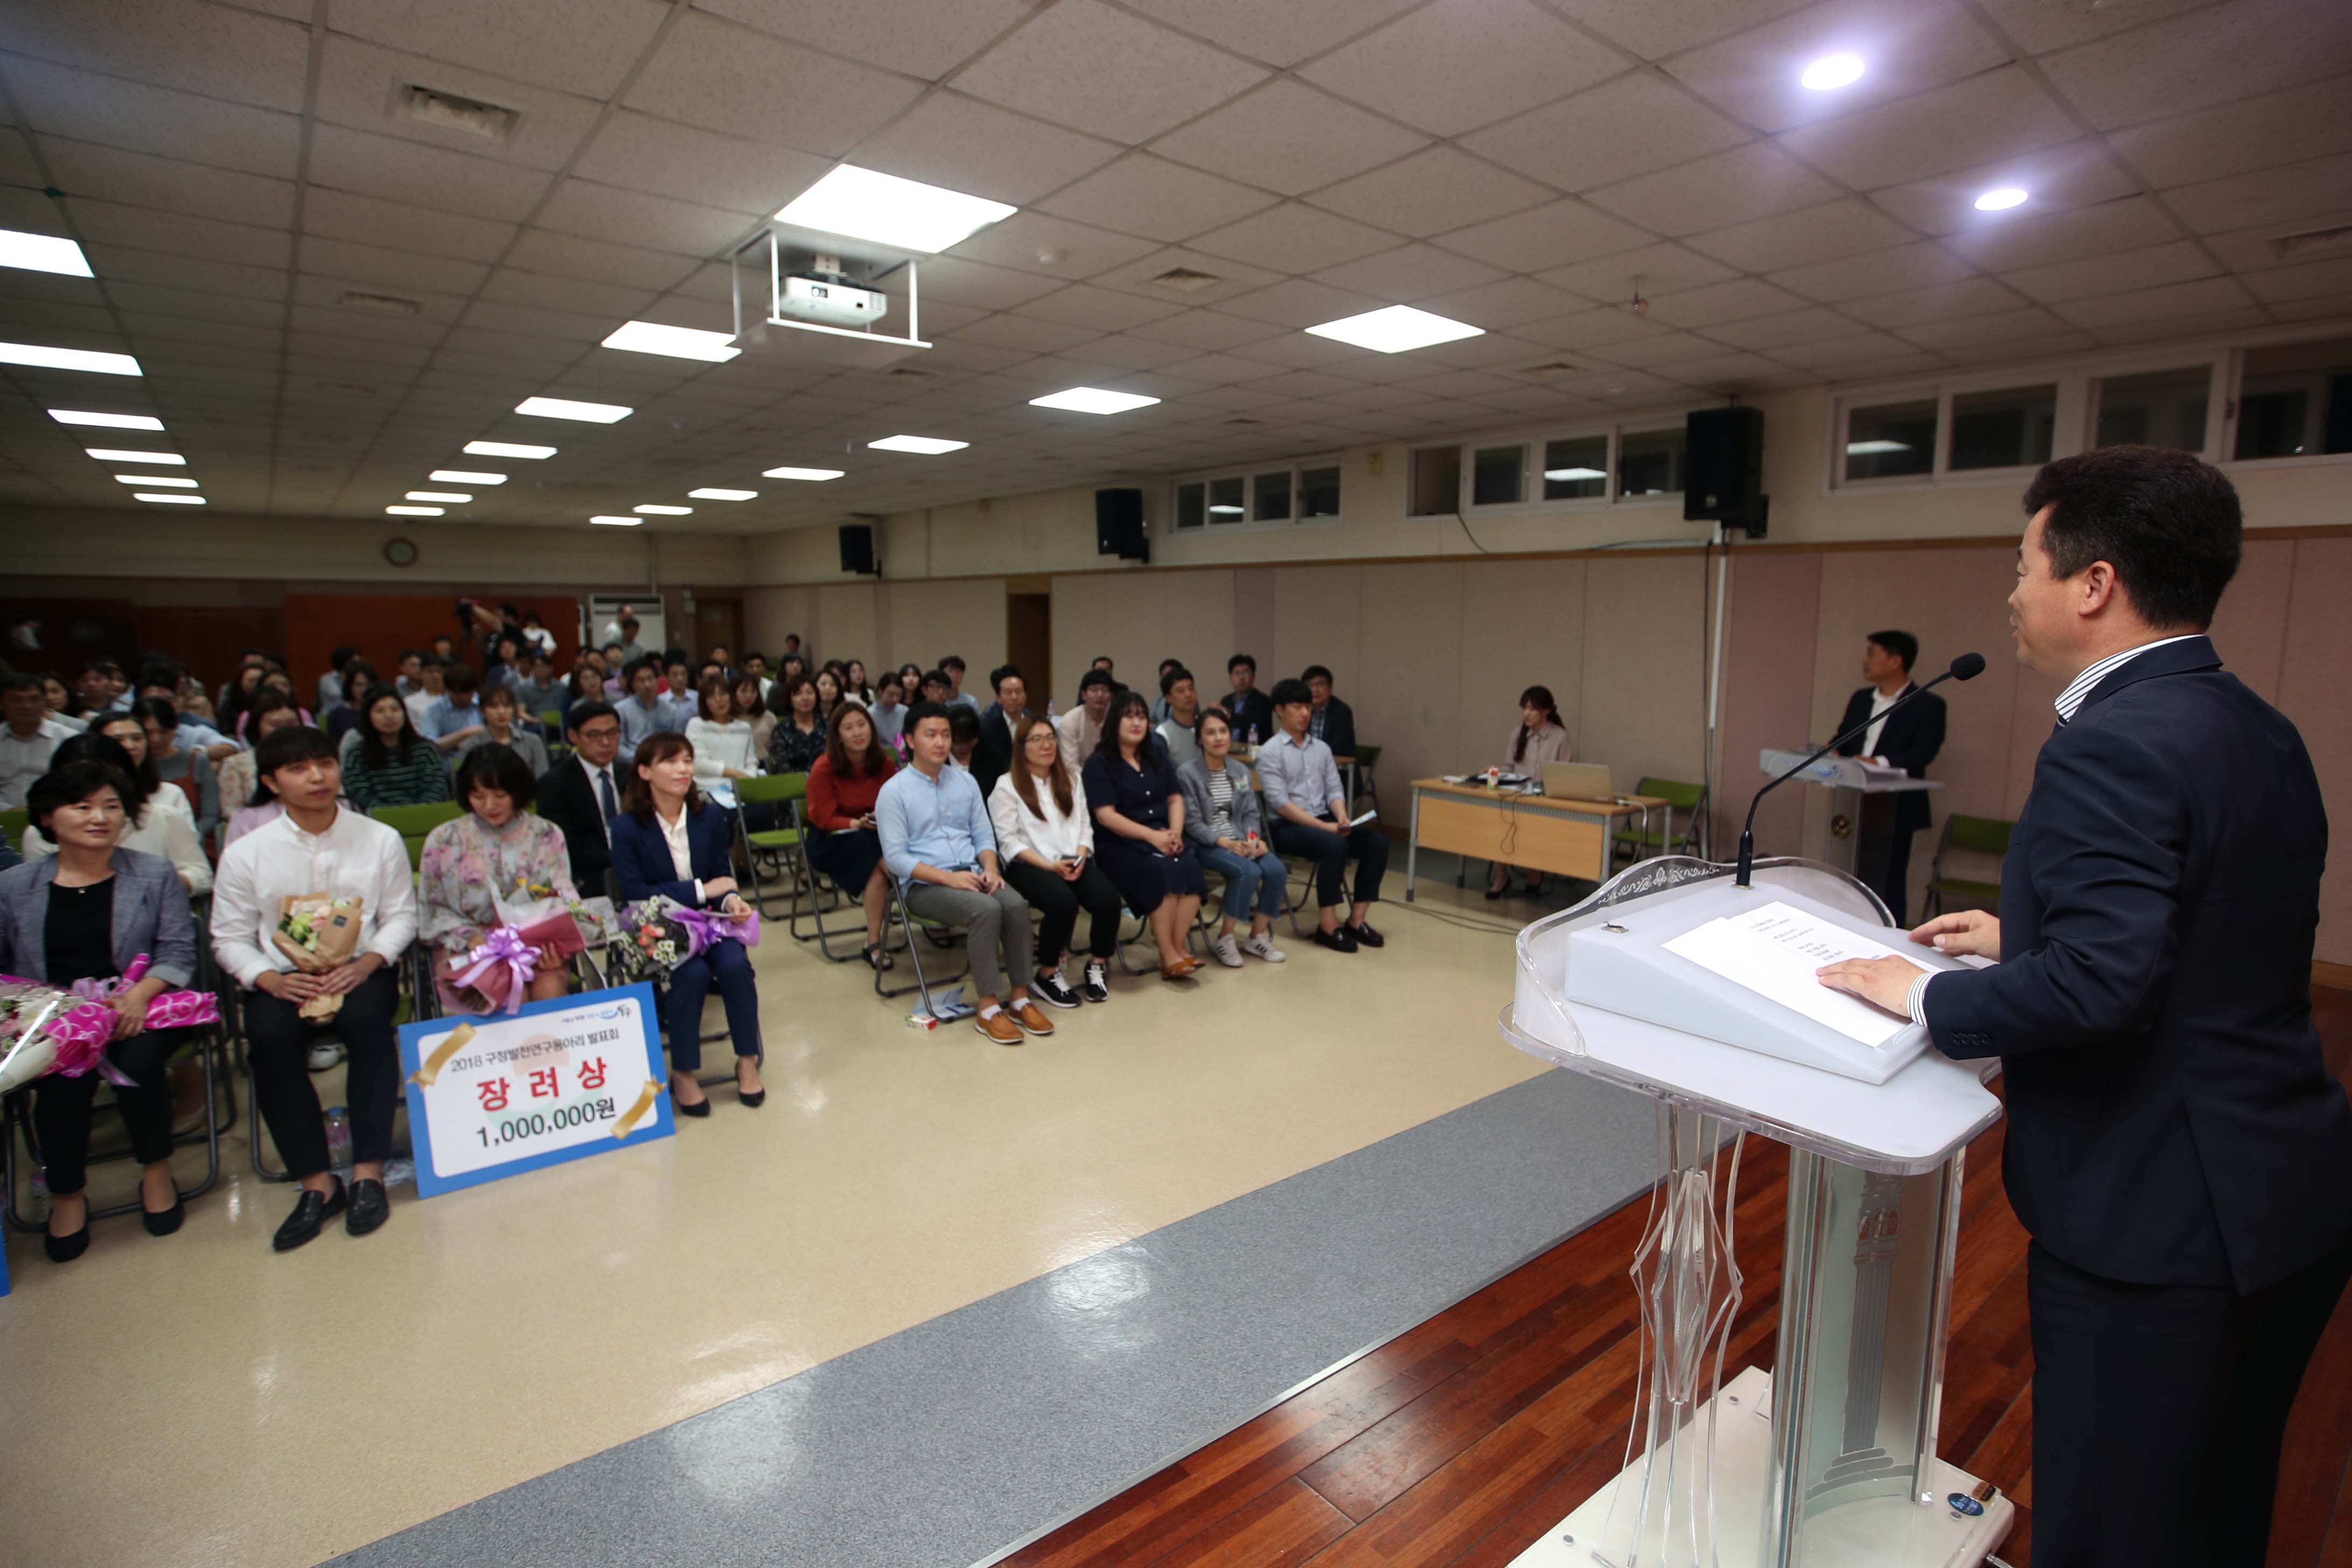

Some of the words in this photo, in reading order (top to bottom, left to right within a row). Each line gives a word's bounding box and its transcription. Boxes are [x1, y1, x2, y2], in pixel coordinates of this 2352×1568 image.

[450, 1055, 483, 1073] 2018
[587, 1027, 620, 1045] 발표회
[477, 1096, 617, 1148] 1,000,000원
